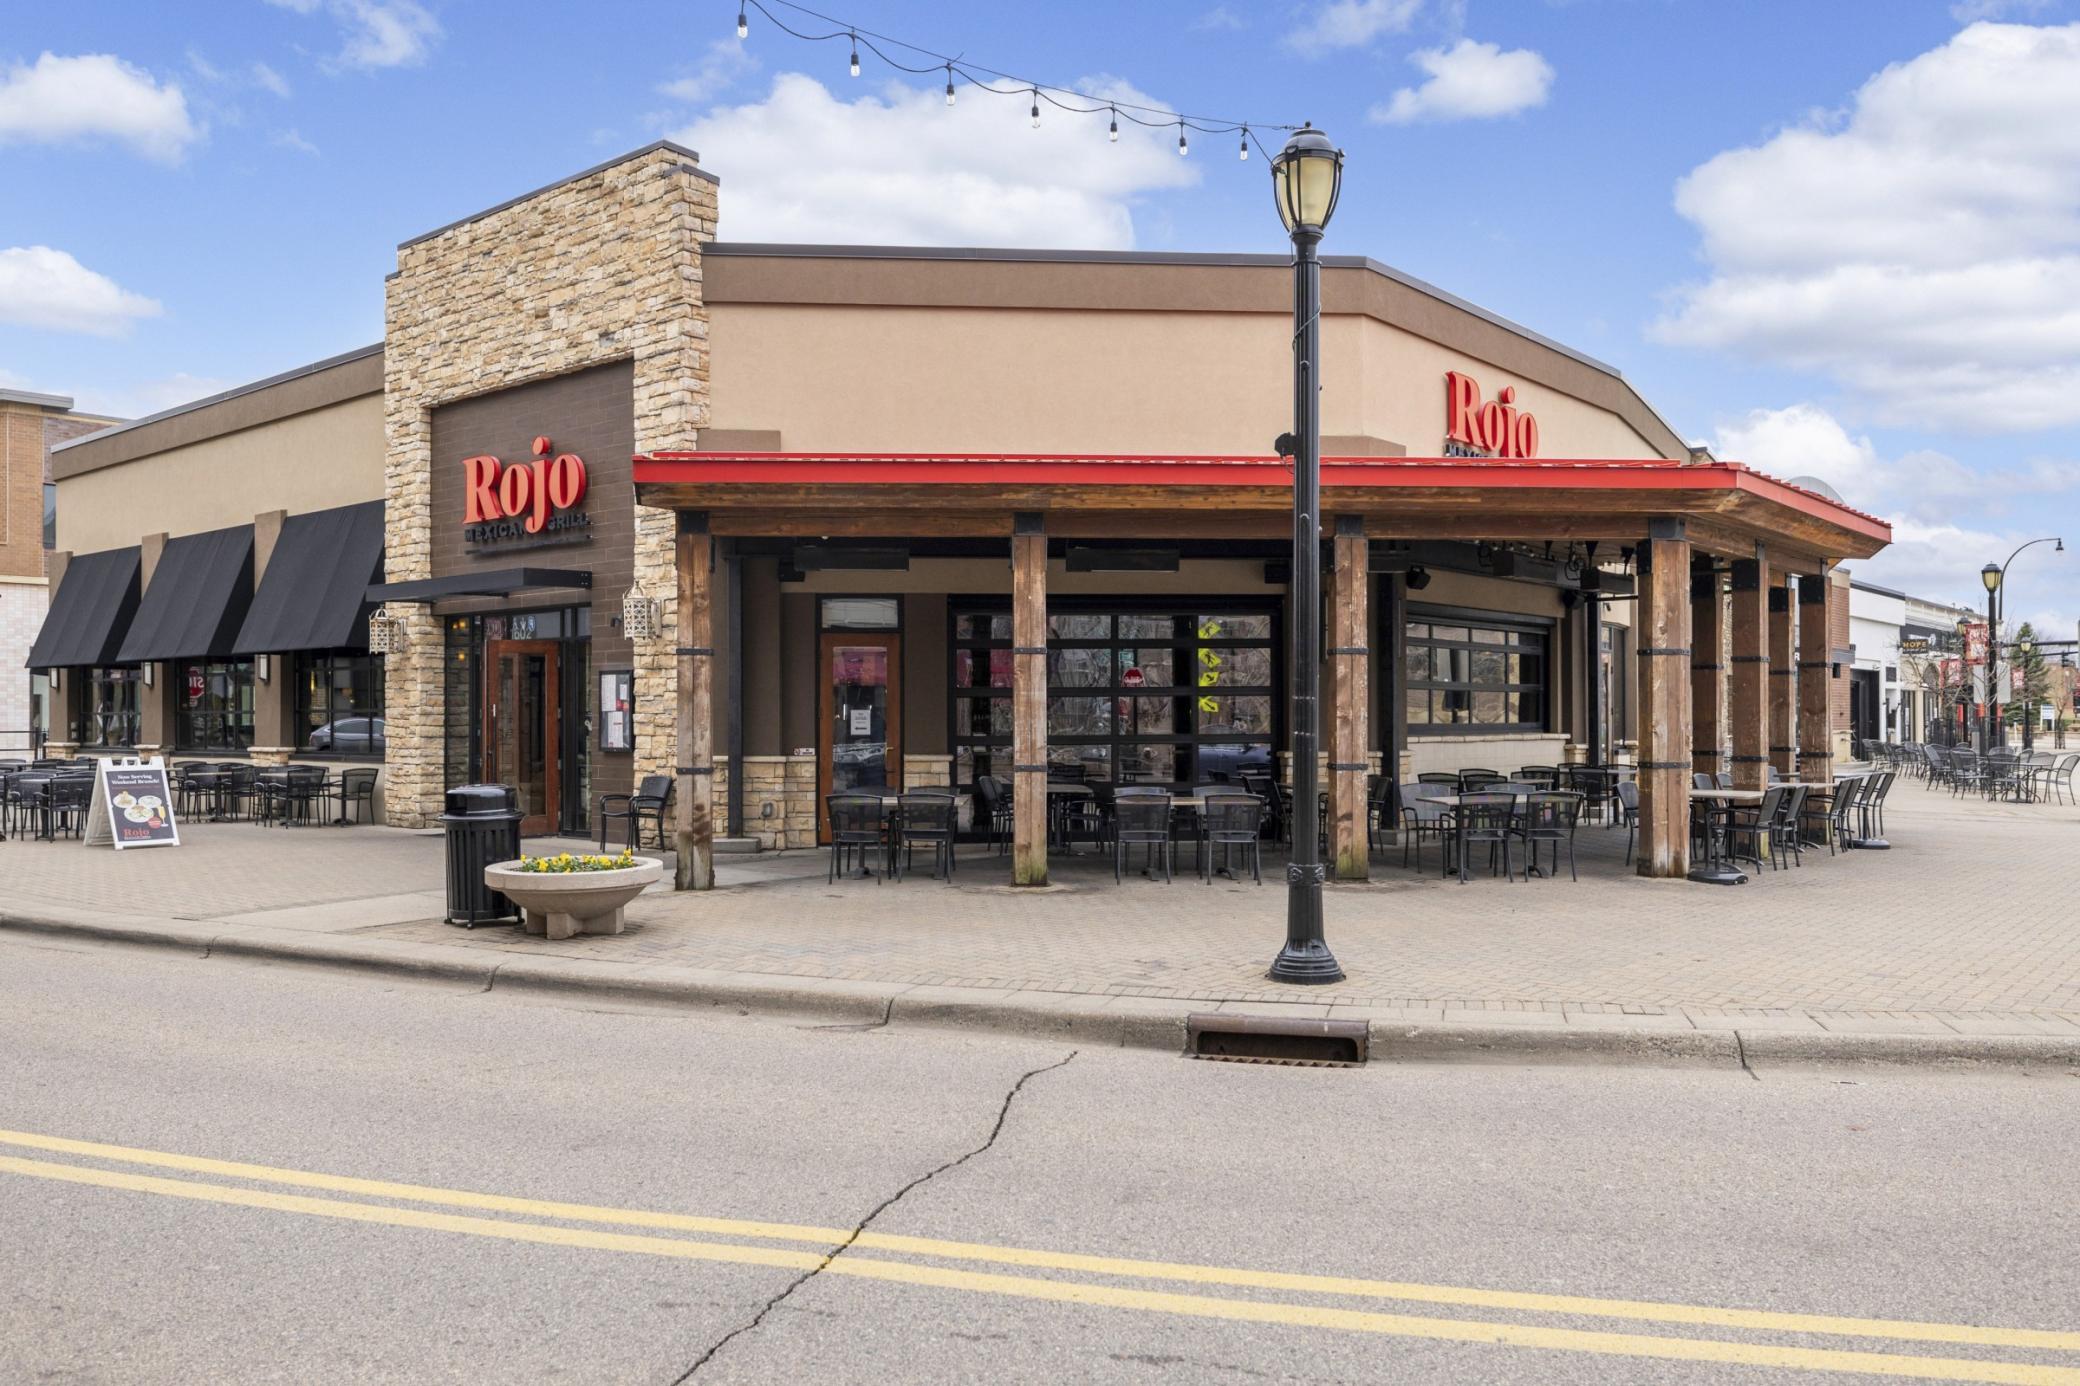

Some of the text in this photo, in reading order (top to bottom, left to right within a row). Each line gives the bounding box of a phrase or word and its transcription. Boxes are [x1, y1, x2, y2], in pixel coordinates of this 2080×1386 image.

[1445, 371, 1539, 458] Rojo
[462, 435, 587, 534] Rojo
[1903, 641, 1927, 649] HOPE
[123, 828, 150, 837] Rojo
